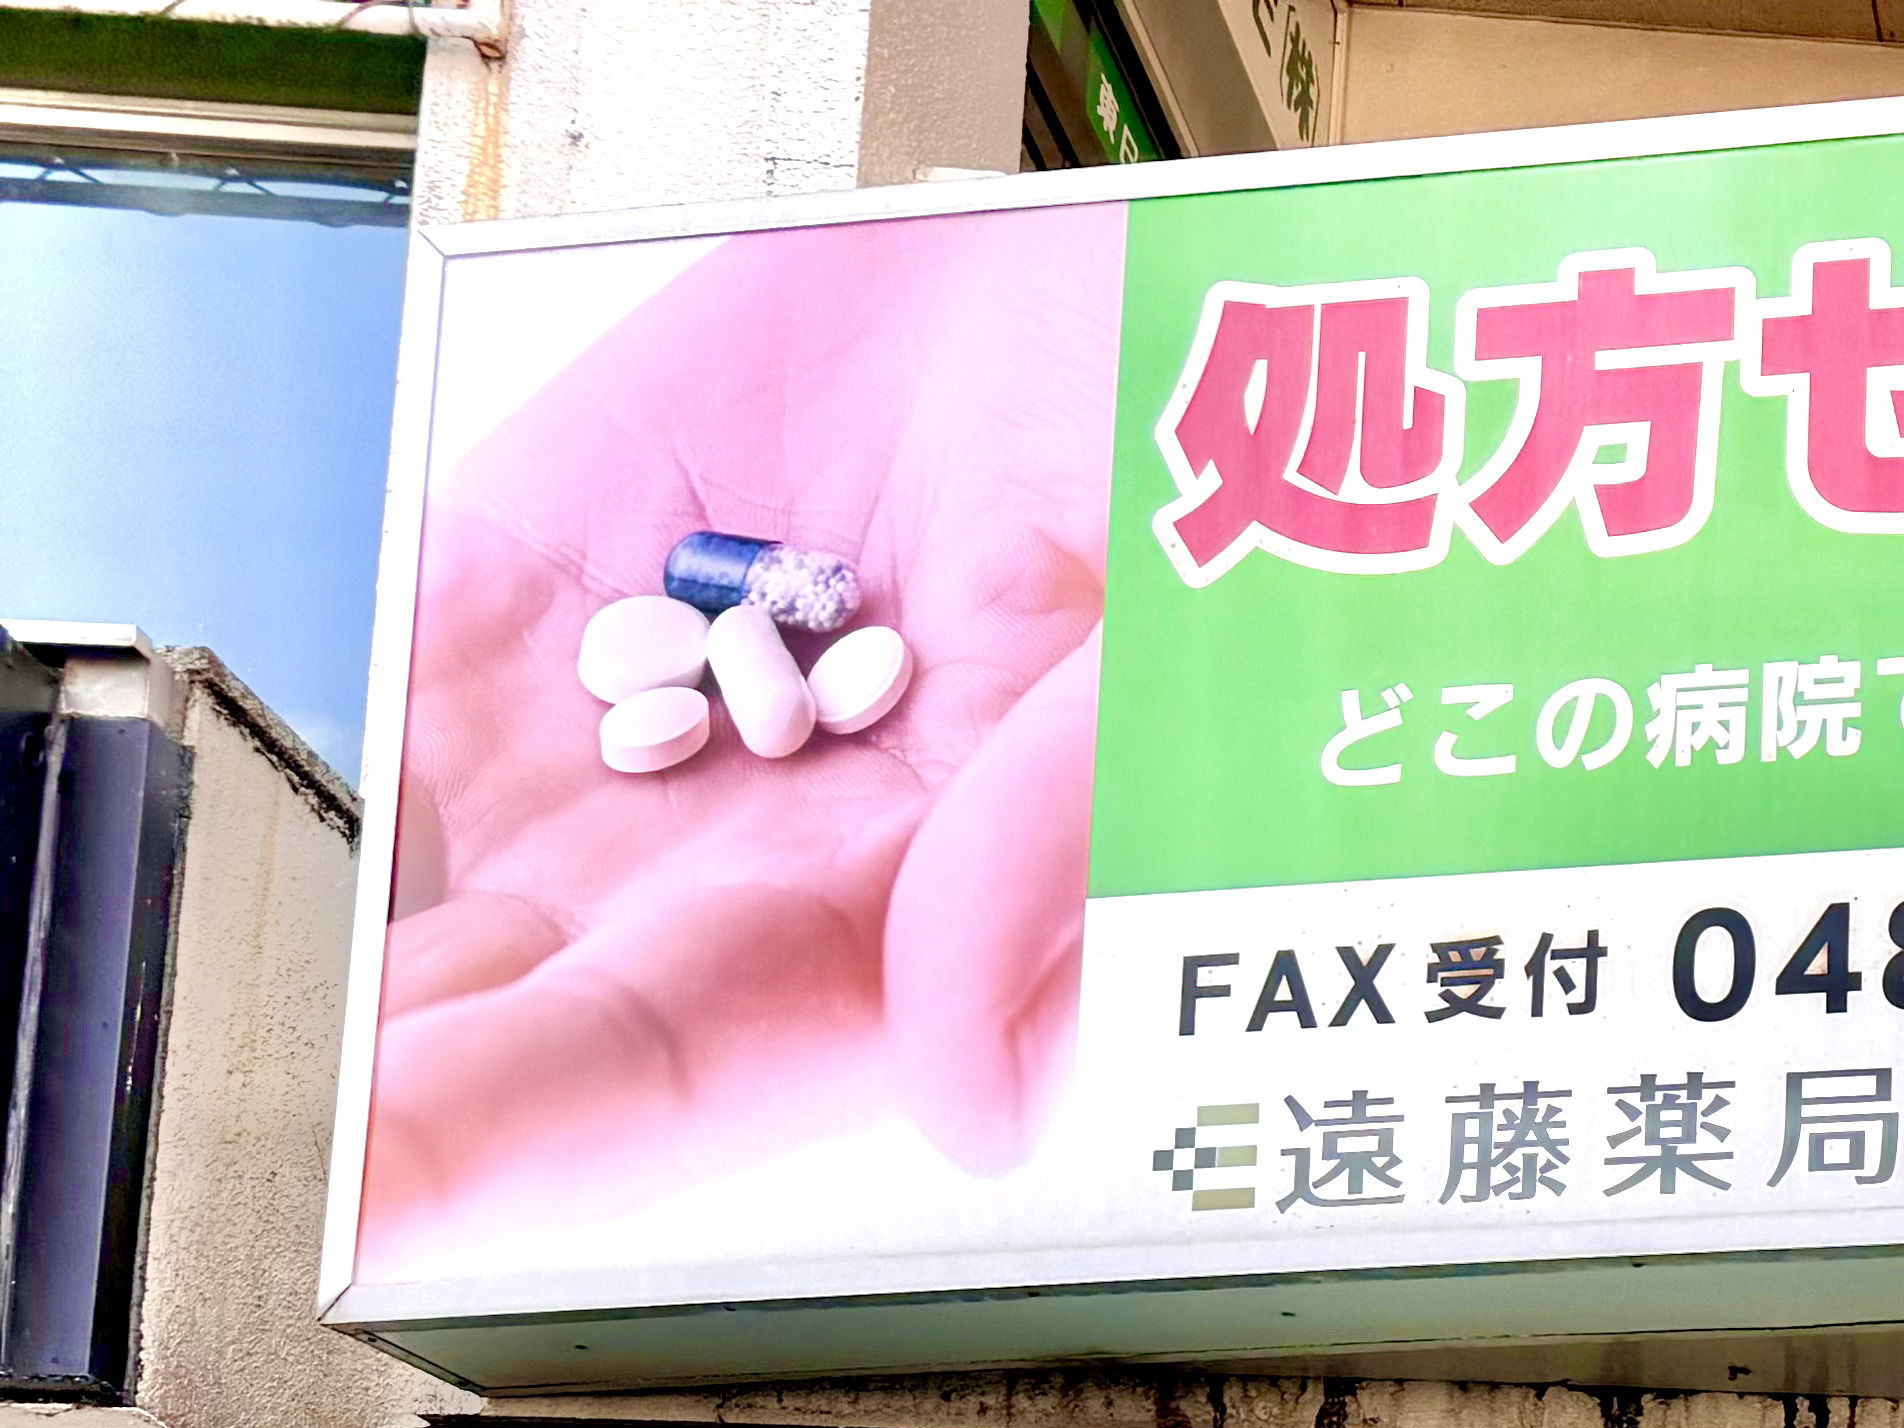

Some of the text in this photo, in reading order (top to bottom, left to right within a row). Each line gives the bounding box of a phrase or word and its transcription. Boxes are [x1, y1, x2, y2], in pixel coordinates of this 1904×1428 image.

[1179, 942, 1397, 1037] FAX
[1424, 928, 1607, 1025] 受付
[1277, 1068, 1899, 1215] 遠藤薬局
